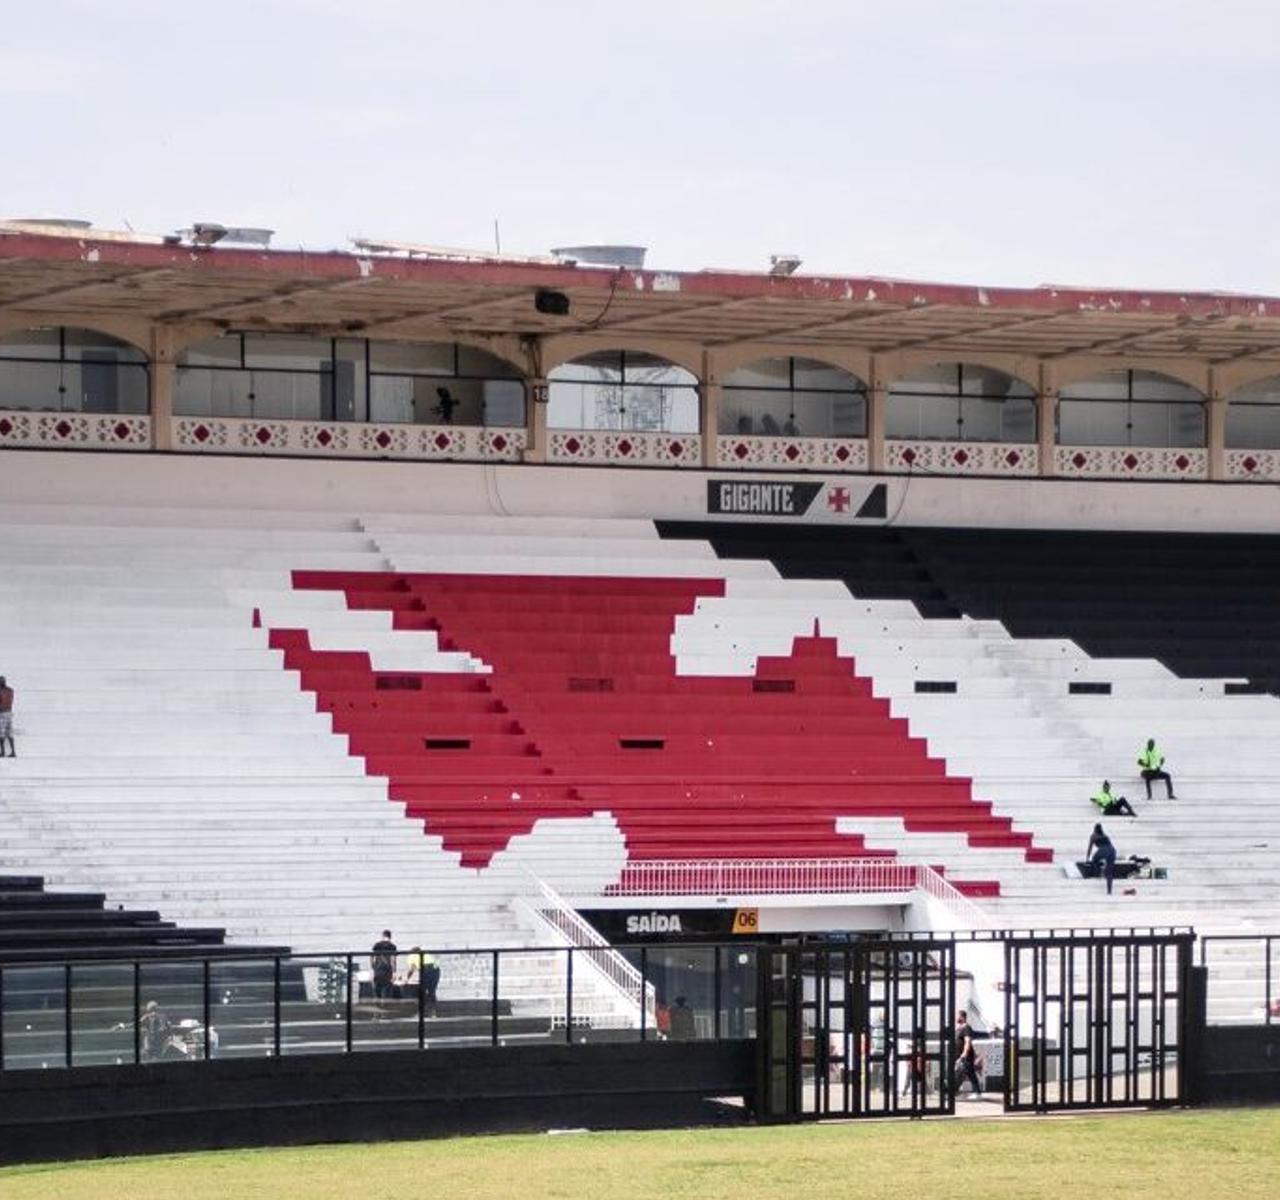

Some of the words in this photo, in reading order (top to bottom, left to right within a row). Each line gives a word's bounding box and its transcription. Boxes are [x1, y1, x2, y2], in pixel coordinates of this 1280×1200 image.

[720, 483, 794, 512] GIGANTE
[627, 912, 682, 932] SAÍDA
[738, 912, 758, 927] 06
